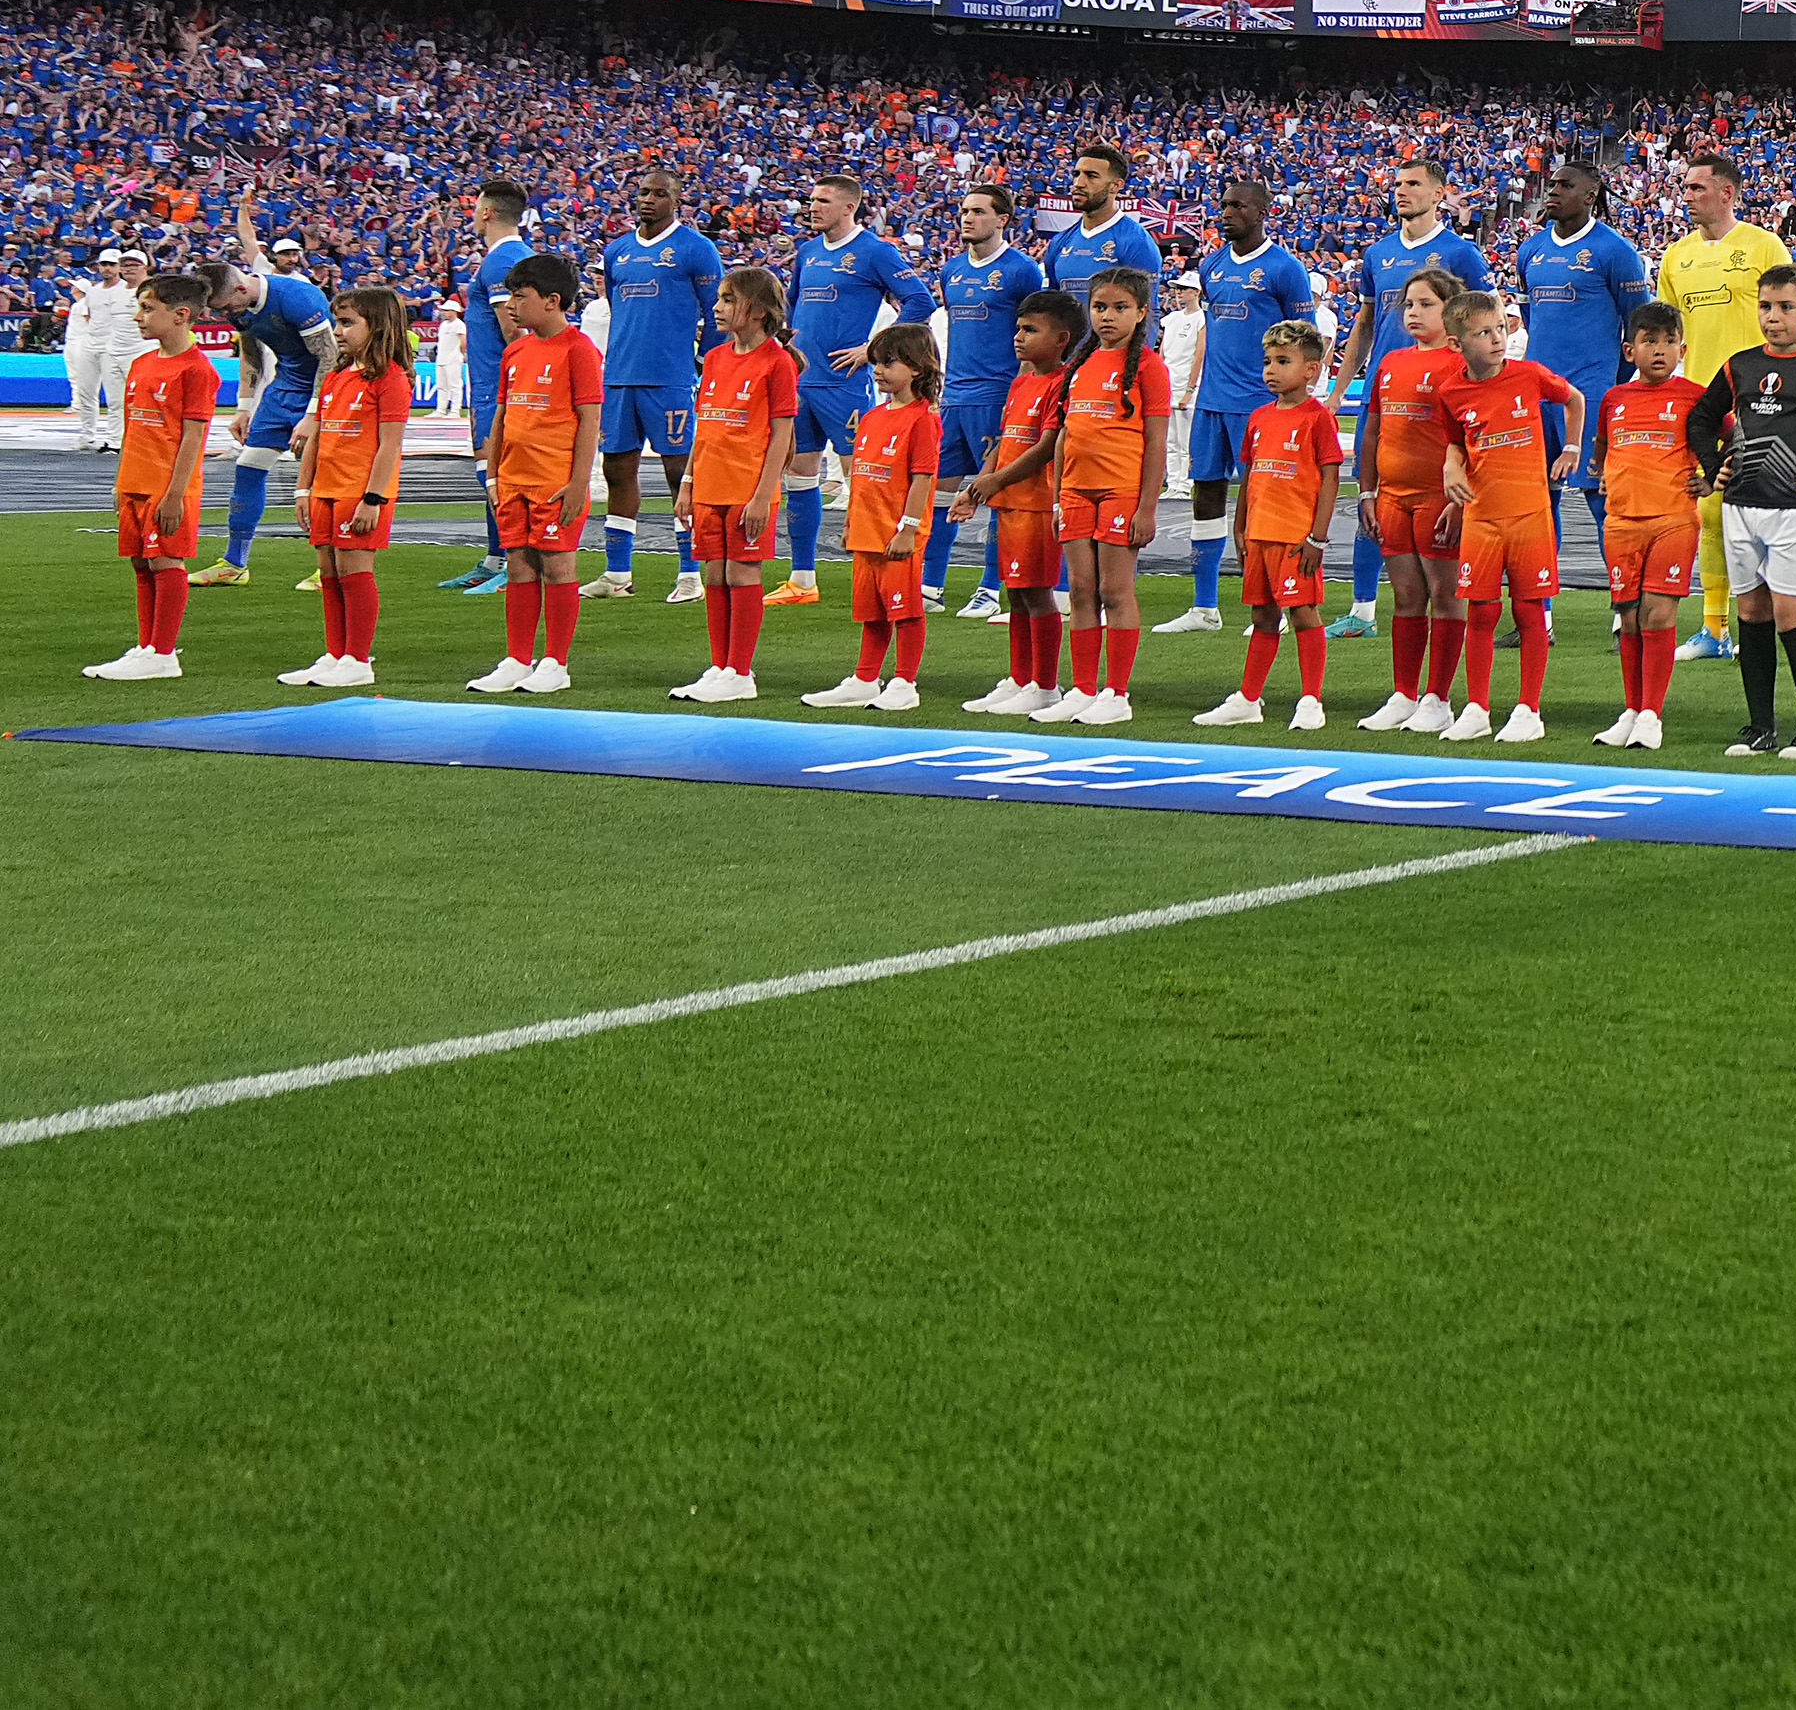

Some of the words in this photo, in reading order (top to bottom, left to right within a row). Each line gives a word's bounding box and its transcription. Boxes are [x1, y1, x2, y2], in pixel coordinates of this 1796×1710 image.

[963, 2, 987, 15] THIS
[990, 4, 1003, 15] IS
[1004, 5, 1027, 17] OUR
[1029, 5, 1054, 18] CITY
[1555, 0, 1570, 8] ON
[1317, 15, 1336, 27] NO
[1340, 16, 1422, 28] SURRENDER
[1439, 12, 1466, 21] STEVE
[1467, 11, 1504, 20] CARROLL
[1750, 402, 1782, 412] EUROPA
[665, 409, 688, 435] 17
[802, 745, 1724, 819] PEACE
